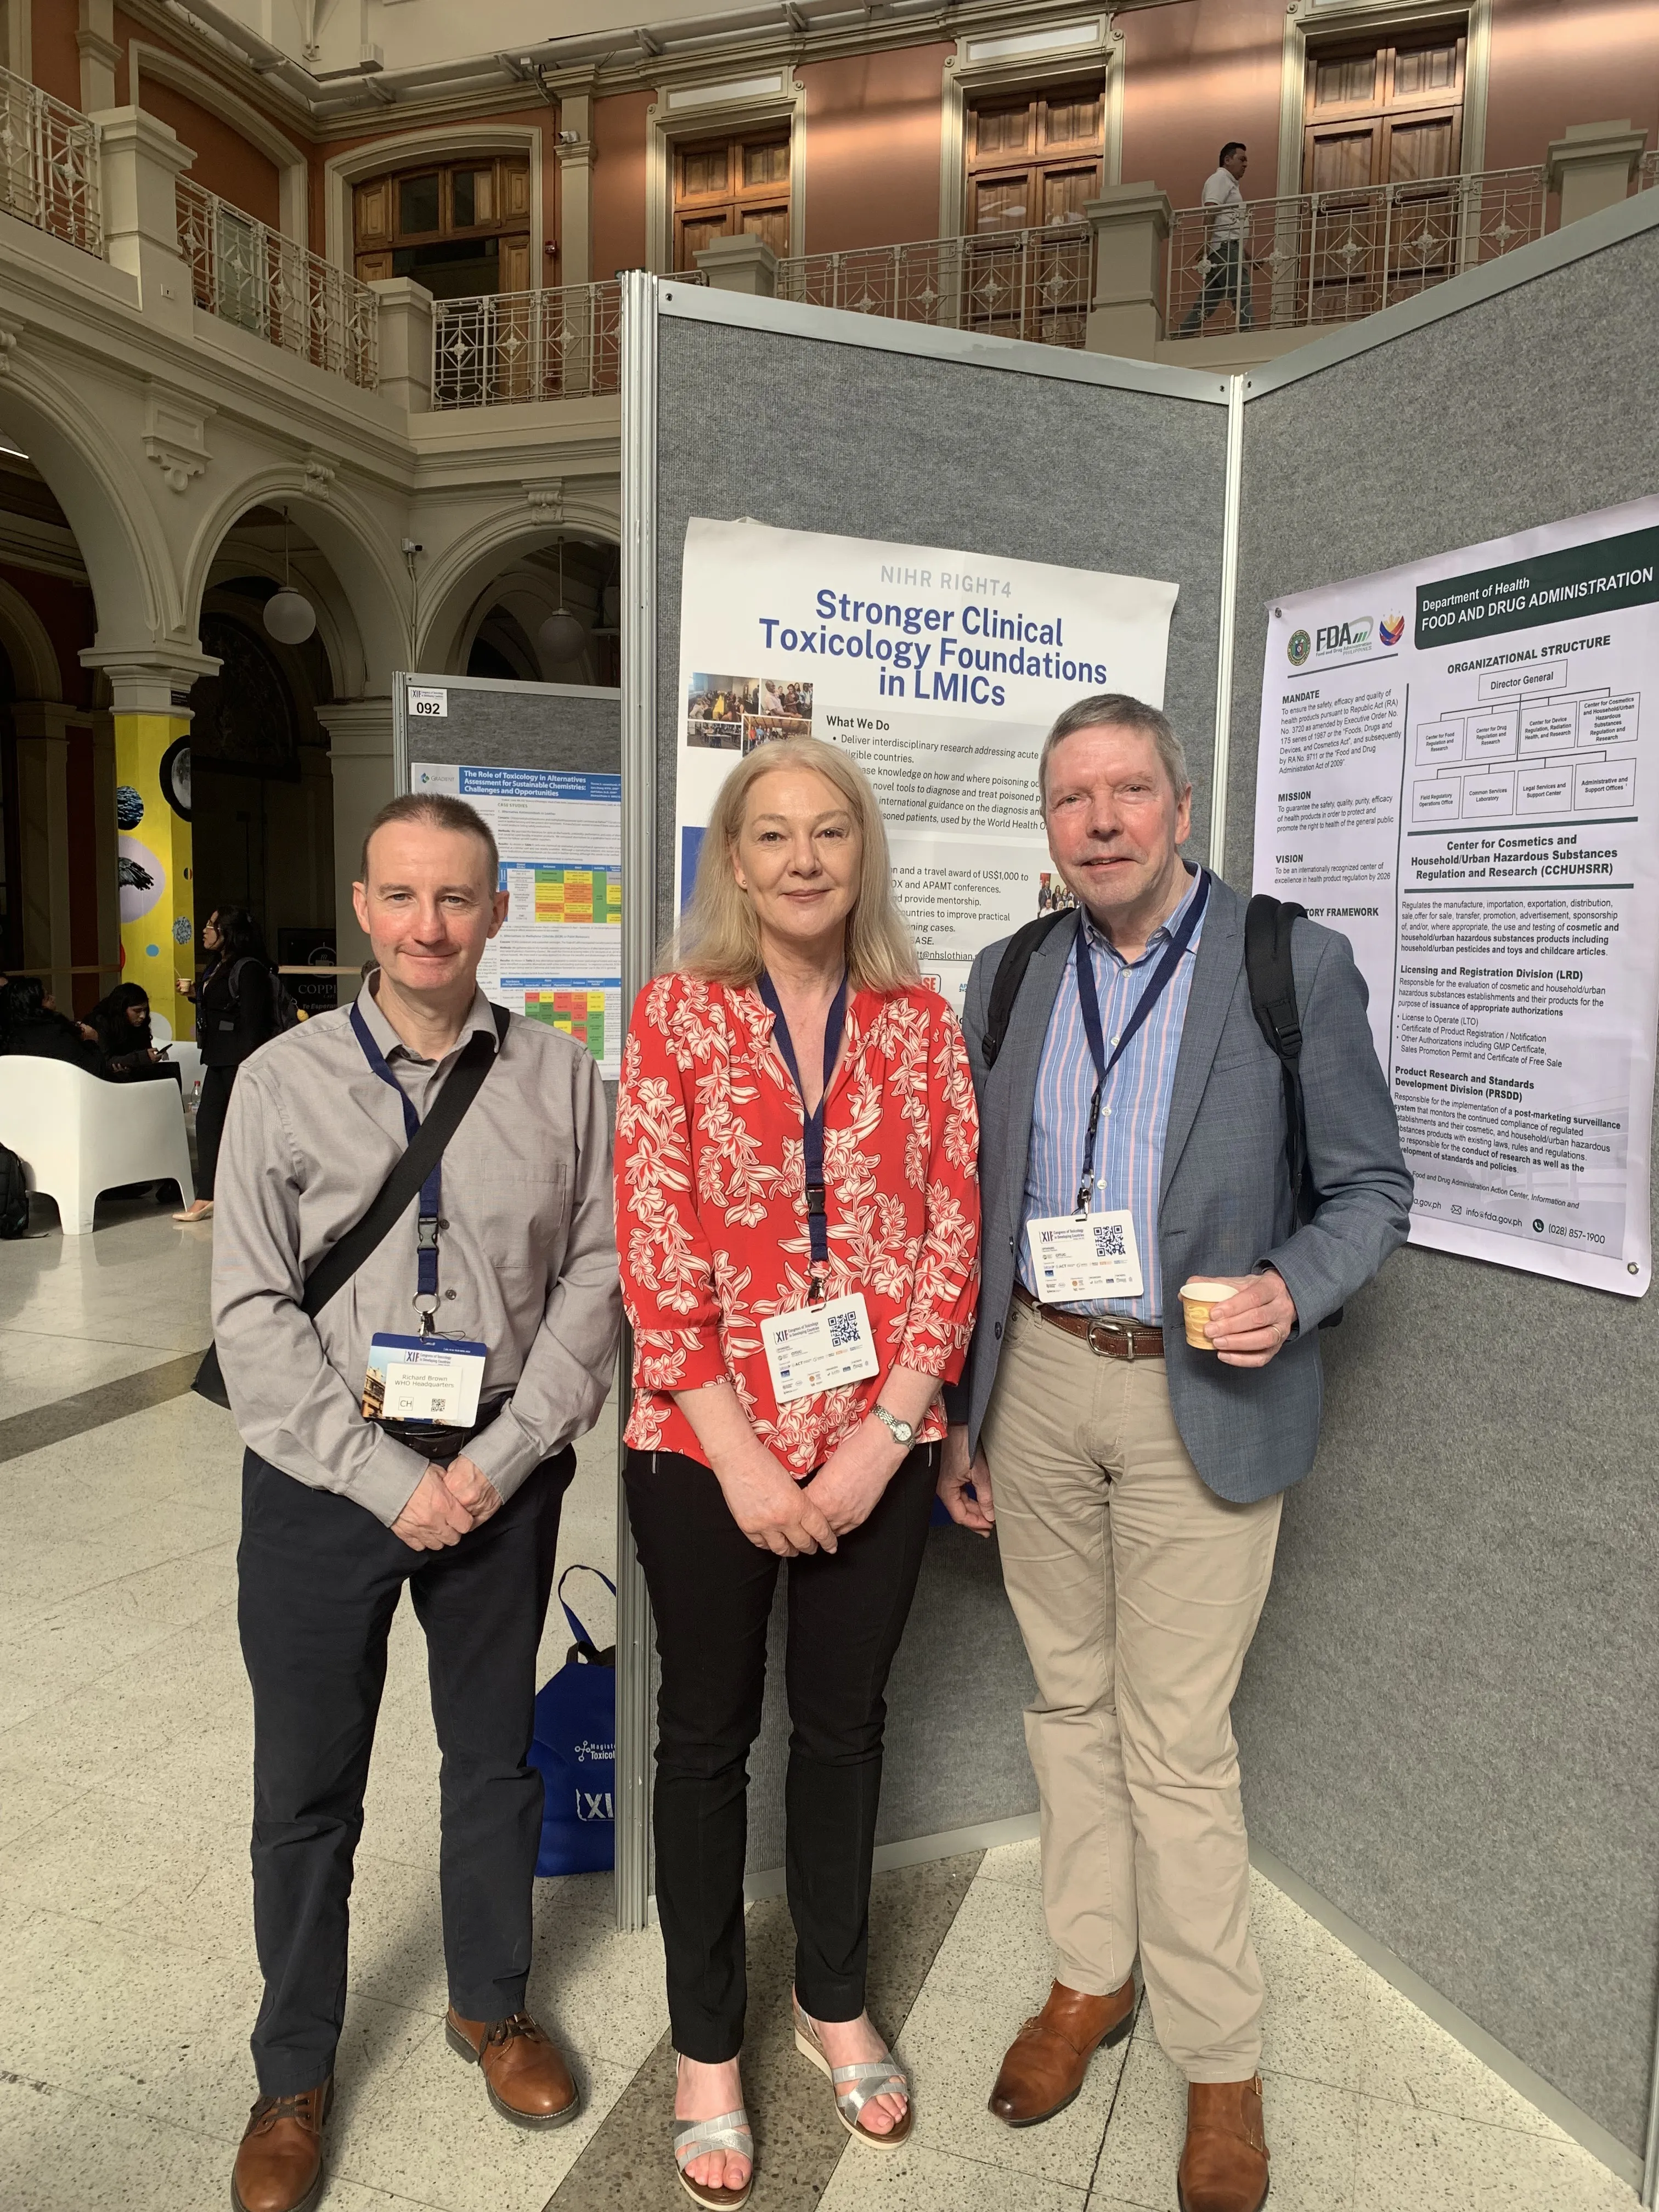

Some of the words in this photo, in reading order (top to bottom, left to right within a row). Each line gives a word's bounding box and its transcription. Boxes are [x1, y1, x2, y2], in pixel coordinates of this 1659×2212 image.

[881, 565, 931, 587] NIHR
[940, 572, 1011, 598] RIGHT4
[1422, 612, 1455, 631] FOOD
[1458, 605, 1484, 623] AND
[1488, 596, 1525, 616] DRUG
[1528, 566, 1653, 607] ADMINISTRATION
[1423, 588, 1479, 611] Department
[1482, 584, 1493, 597] of
[1495, 577, 1529, 595] Health
[816, 589, 954, 635] Stronger
[962, 606, 1063, 646] Clinical
[1316, 622, 1351, 652] FDA
[759, 618, 931, 670] Toxicology
[940, 637, 1106, 684] Foundations
[1343, 646, 1372, 656] PHILIPPINES
[1447, 649, 1537, 674] ORGANIZATIONAL
[1541, 635, 1610, 657] STRUCTURE
[879, 667, 904, 697] in
[915, 669, 1005, 706] LMICs
[1491, 679, 1521, 690] Director
[1523, 671, 1553, 684] General
[1282, 690, 1319, 704] MANDATE
[417, 702, 440, 714] 092
[826, 715, 854, 727] What
[857, 718, 873, 729] We
[876, 720, 889, 730] Do
[841, 734, 870, 745] Deliver
[872, 737, 938, 752] interdisciplinary
[940, 745, 973, 753] research
[974, 746, 1016, 758] addressing
[873, 753, 914, 763] countries.
[464, 778, 501, 786] Assessment
[512, 780, 548, 788] Sustainable
[502, 772, 538, 782] Toxicology
[878, 766, 921, 780] knowledge
[934, 771, 950, 780] how
[951, 773, 965, 781] and
[966, 774, 990, 783] where
[992, 777, 1029, 788] poisoning
[464, 785, 500, 794] Challenges
[514, 788, 559, 796] Opportunities
[873, 782, 894, 791] novel
[896, 783, 915, 792] tools
[917, 785, 924, 793] to
[926, 785, 960, 796] diagnose
[962, 789, 976, 797] and
[978, 790, 997, 798] treat
[999, 791, 1034, 801] poisoned
[1278, 791, 1311, 802] MISSION
[879, 796, 927, 808] international
[928, 800, 963, 810] guidance
[977, 803, 989, 812] the
[991, 804, 1028, 815] diagnosis
[906, 812, 938, 823] patients,
[941, 816, 959, 824] used
[961, 816, 971, 826] by
[973, 817, 985, 826] the
[988, 818, 1010, 827] World
[1012, 820, 1037, 829] Health
[1447, 841, 1479, 850] Center
[1481, 839, 1495, 848] for
[1498, 836, 1553, 848] Cosmetics
[1557, 834, 1577, 845] and
[1276, 854, 1303, 863] VISION
[1411, 854, 1490, 866] Household/Urban
[1493, 851, 1549, 862] Hazardous
[1552, 849, 1617, 860] Substances
[899, 866, 915, 874] and
[924, 867, 946, 876] travel
[948, 869, 971, 878] award
[983, 870, 1019, 880] US$1,000
[1416, 869, 1465, 881] Regulation
[1468, 868, 1486, 877] and
[1489, 866, 1537, 877] Research
[1541, 863, 1612, 878] (CCHUHSRR)
[905, 880, 920, 889] and
[922, 881, 952, 890] APAMT
[953, 883, 1001, 893] conferences.
[905, 895, 935, 904] provide
[937, 897, 981, 907] mentorship.
[947, 910, 977, 919] improve
[978, 913, 1010, 921] practical
[1327, 907, 1379, 916] FRAMEWORK
[1401, 965, 1438, 976] Licensing
[1441, 967, 1457, 975] and
[1460, 967, 1513, 978] Registration
[1516, 969, 1553, 978] Division
[1556, 970, 1583, 982] (LRD)
[1402, 1013, 1424, 1022] License
[1434, 1015, 1459, 1024] Operate
[1461, 1017, 1478, 1027] (LTO)
[1395, 1066, 1426, 1077] Product
[1429, 1069, 1468, 1081] Research
[1471, 1075, 1486, 1083] and
[1489, 1076, 1534, 1089] Standards
[1395, 1077, 1447, 1091] Development
[1450, 1084, 1483, 1096] Division
[1486, 1088, 1522, 1103] (PRSDD)
[1466, 1207, 1522, 1227] info@fda.gov.ph
[1548, 1223, 1567, 1236] (028)
[1569, 1229, 1605, 1244] 857-1900
